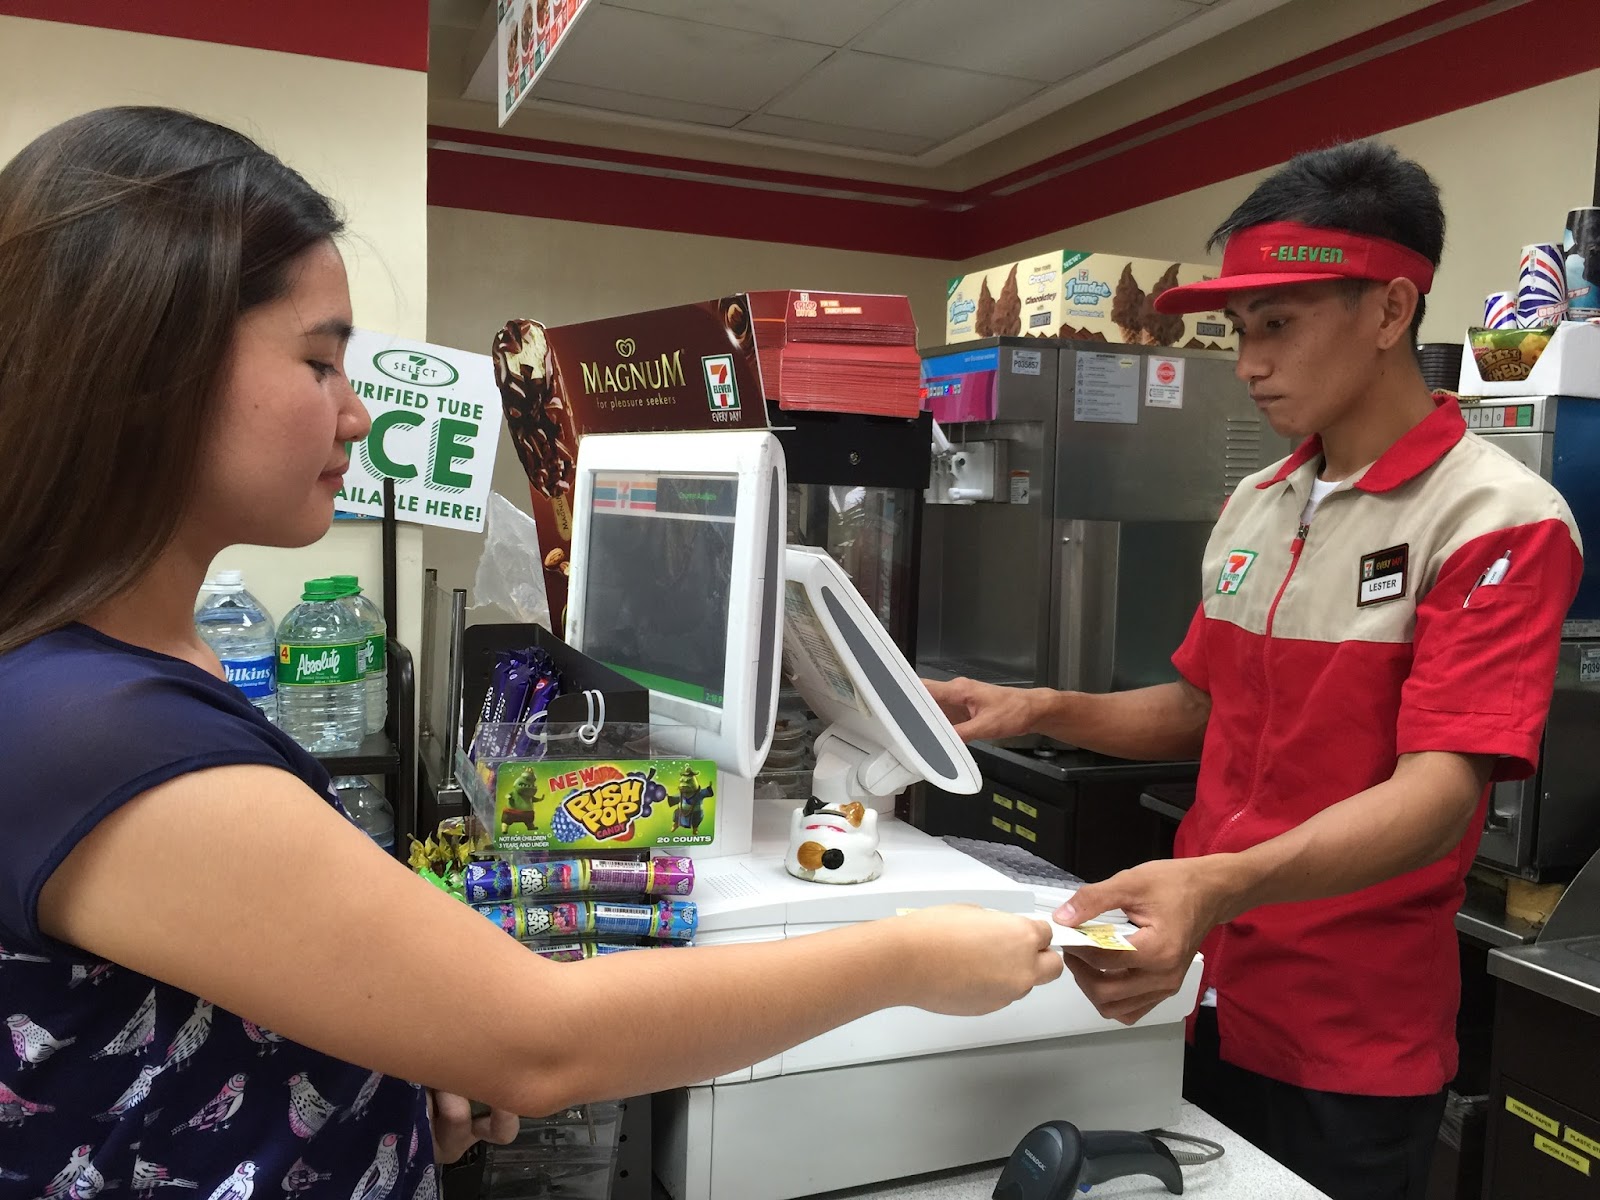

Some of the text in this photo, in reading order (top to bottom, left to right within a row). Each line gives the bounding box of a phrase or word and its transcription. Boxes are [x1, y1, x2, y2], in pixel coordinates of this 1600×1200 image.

[393, 361, 438, 378] SELECT
[580, 350, 686, 395] MAGNUM
[351, 379, 484, 420] URIFIED TUBE
[596, 393, 676, 411] for pleasure seekers
[711, 411, 728, 422] EVERY
[345, 410, 479, 489] CE
[425, 499, 482, 523] HERE!
[1369, 579, 1397, 593] LESTER
[281, 646, 289, 659] 4
[296, 648, 341, 681] Absolute
[1581, 662, 1600, 674] P039
[485, 686, 494, 722] DAIRY
[548, 767, 596, 793] NEW
[566, 779, 644, 820] PUSH
[583, 801, 638, 833] POP
[595, 824, 626, 840] CANDY
[673, 835, 711, 843] COUNTS
[520, 868, 532, 897] PUSH
[531, 868, 543, 893] POP
[527, 907, 539, 936] PUSH
[537, 907, 550, 934] POP
[1512, 1103, 1552, 1128] THERMAL PAPER
[1542, 1142, 1560, 1155] SPOON
[1565, 1154, 1580, 1165] FORK
[1570, 1134, 1591, 1149] PLASTIC
